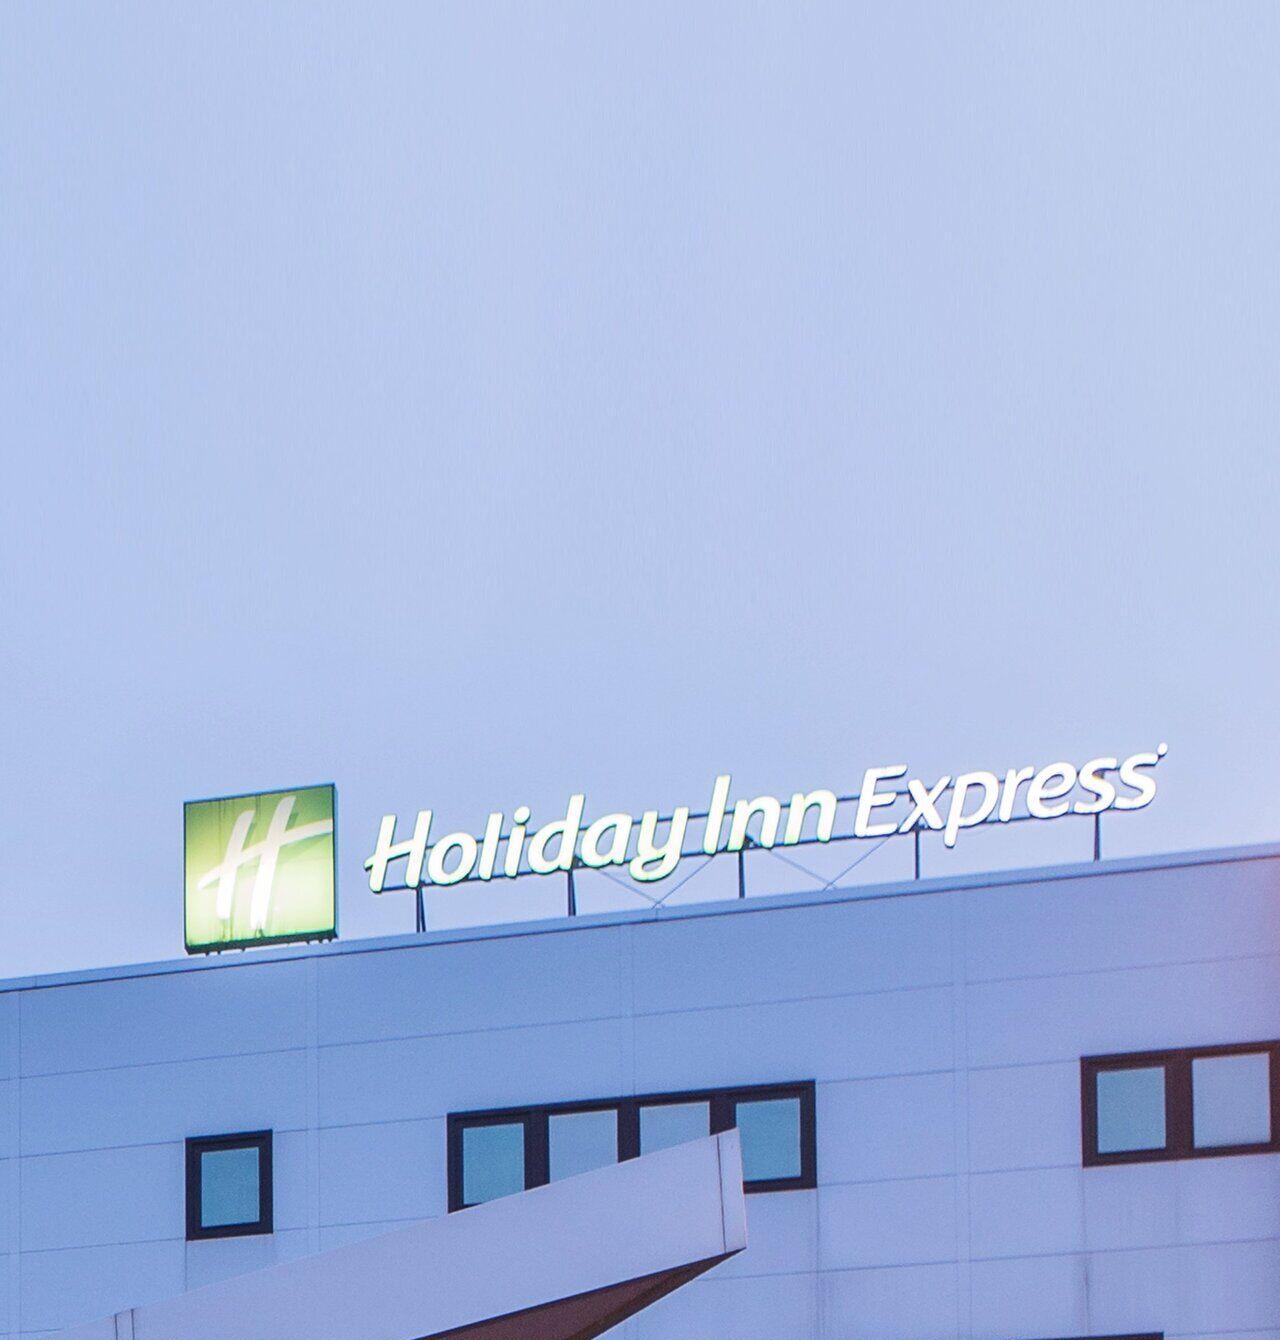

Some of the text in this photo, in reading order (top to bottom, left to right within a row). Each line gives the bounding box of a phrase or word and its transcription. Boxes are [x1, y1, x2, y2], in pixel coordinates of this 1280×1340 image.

[364, 752, 1160, 893] Holiday Inn Express
